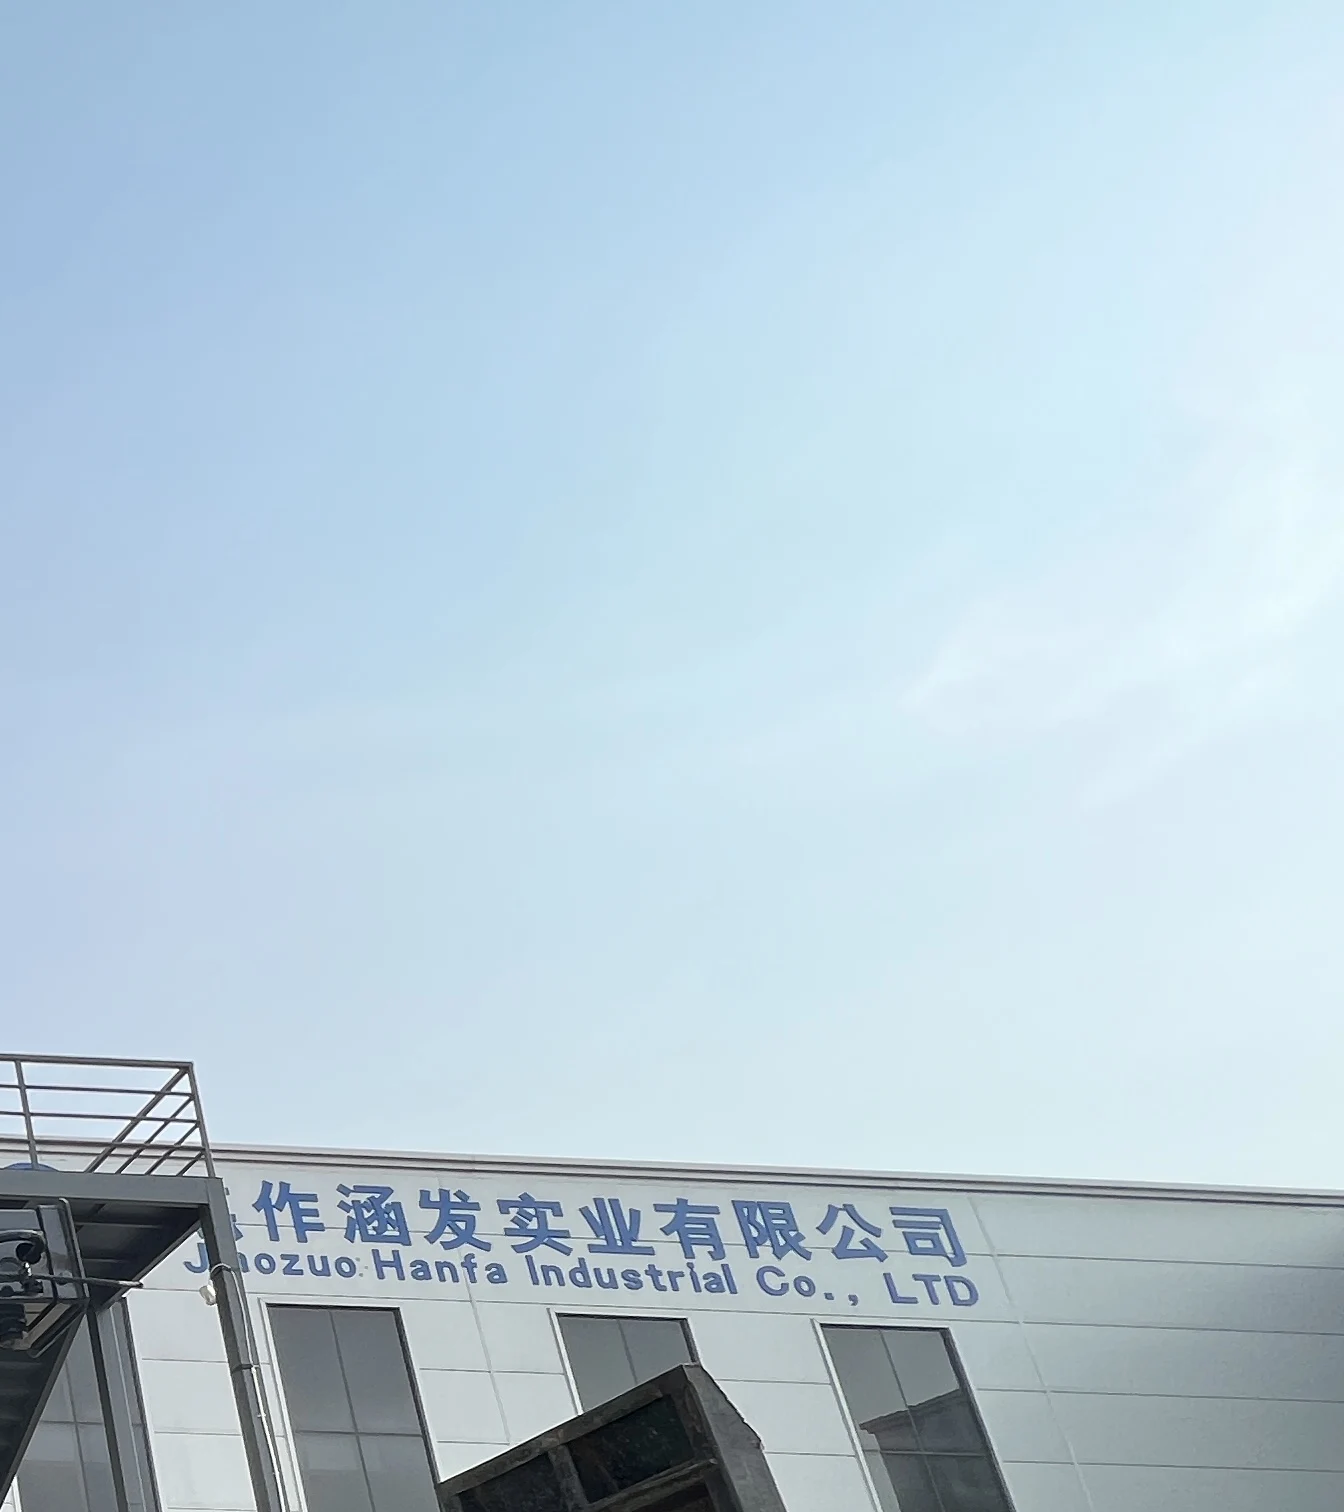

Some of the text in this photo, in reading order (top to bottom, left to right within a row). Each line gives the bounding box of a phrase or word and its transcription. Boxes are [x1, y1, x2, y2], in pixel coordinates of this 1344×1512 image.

[197, 1180, 967, 1267] 作涵发实业有限公司
[183, 1242, 980, 1306] Jozuo Hanfa Industrial Co., LTD
